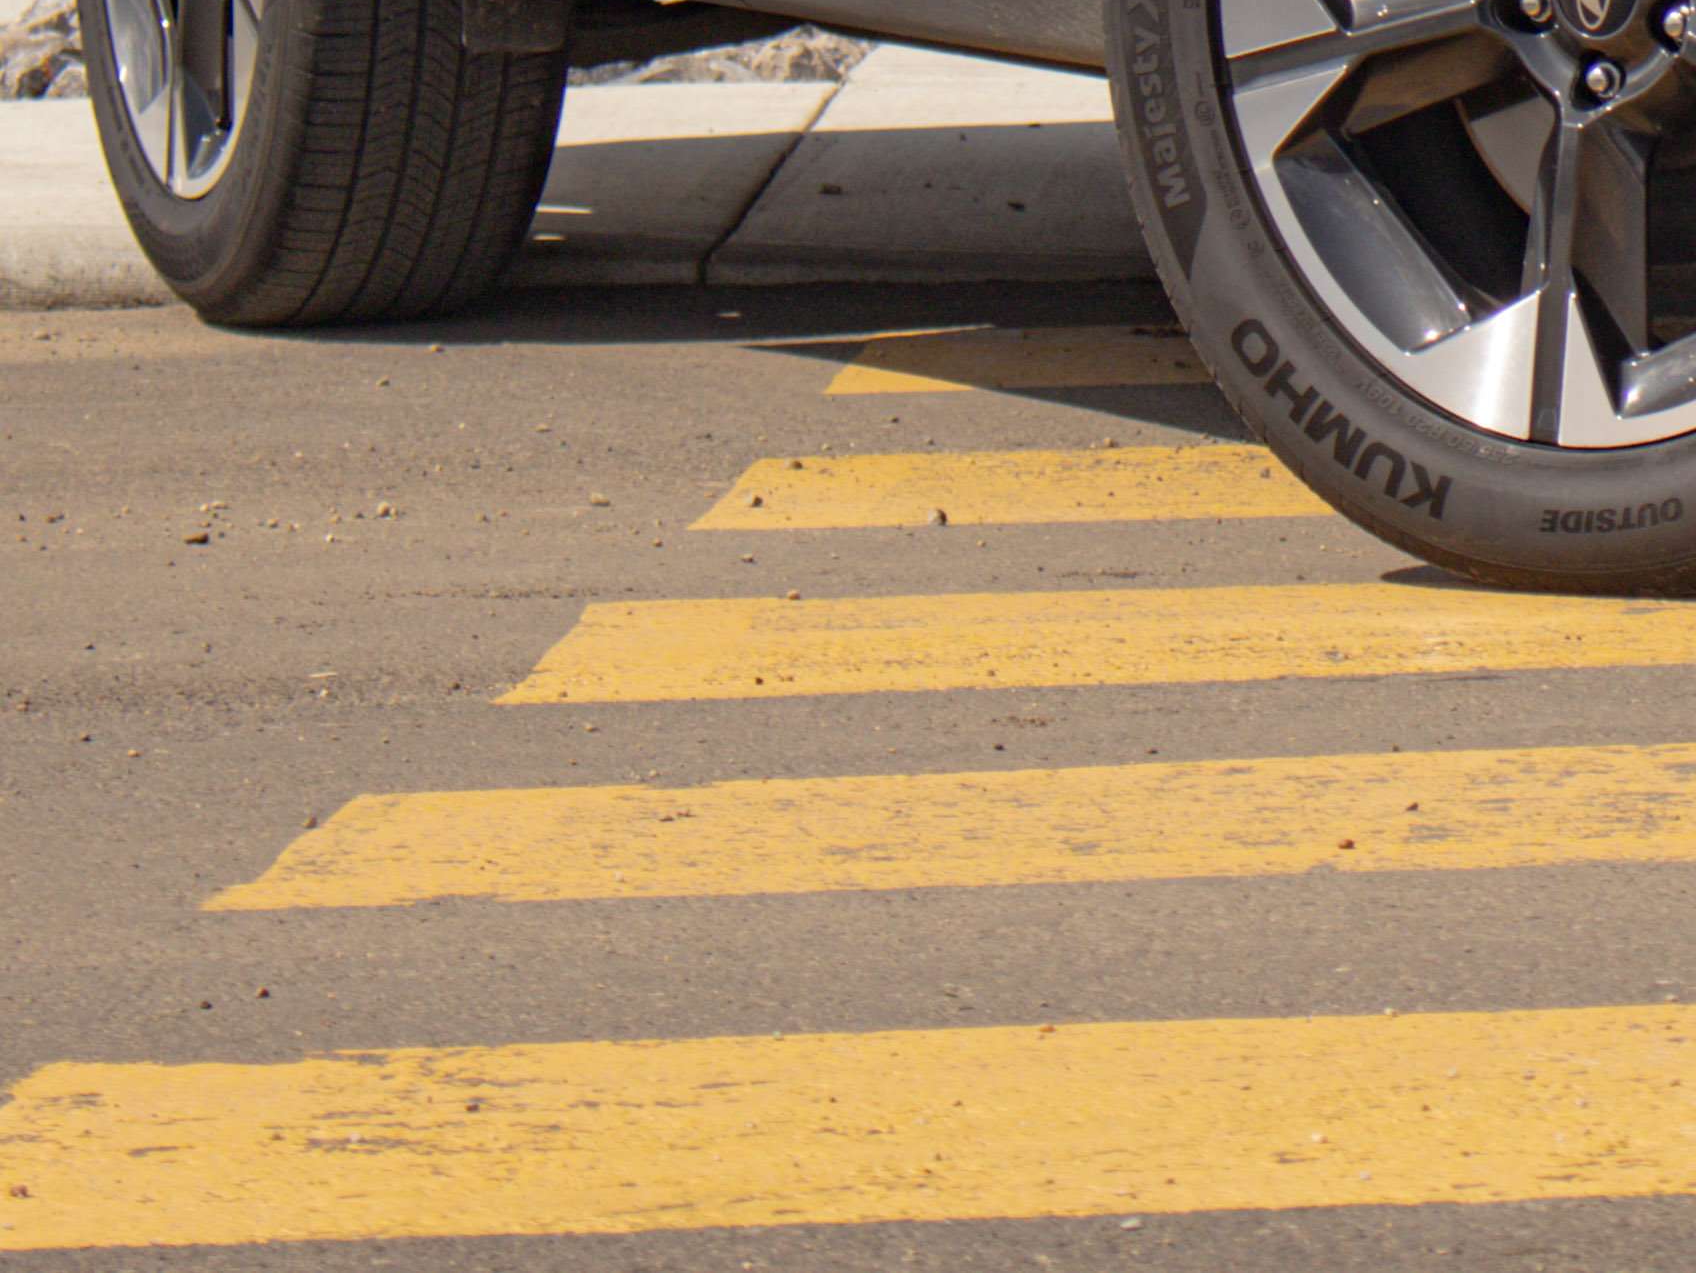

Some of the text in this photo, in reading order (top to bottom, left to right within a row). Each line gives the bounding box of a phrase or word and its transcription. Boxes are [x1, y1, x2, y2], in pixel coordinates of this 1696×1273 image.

[1130, 24, 1191, 208] Majesty
[1230, 317, 1453, 520] KUMHO
[1538, 495, 1684, 534] OUTSIDE
